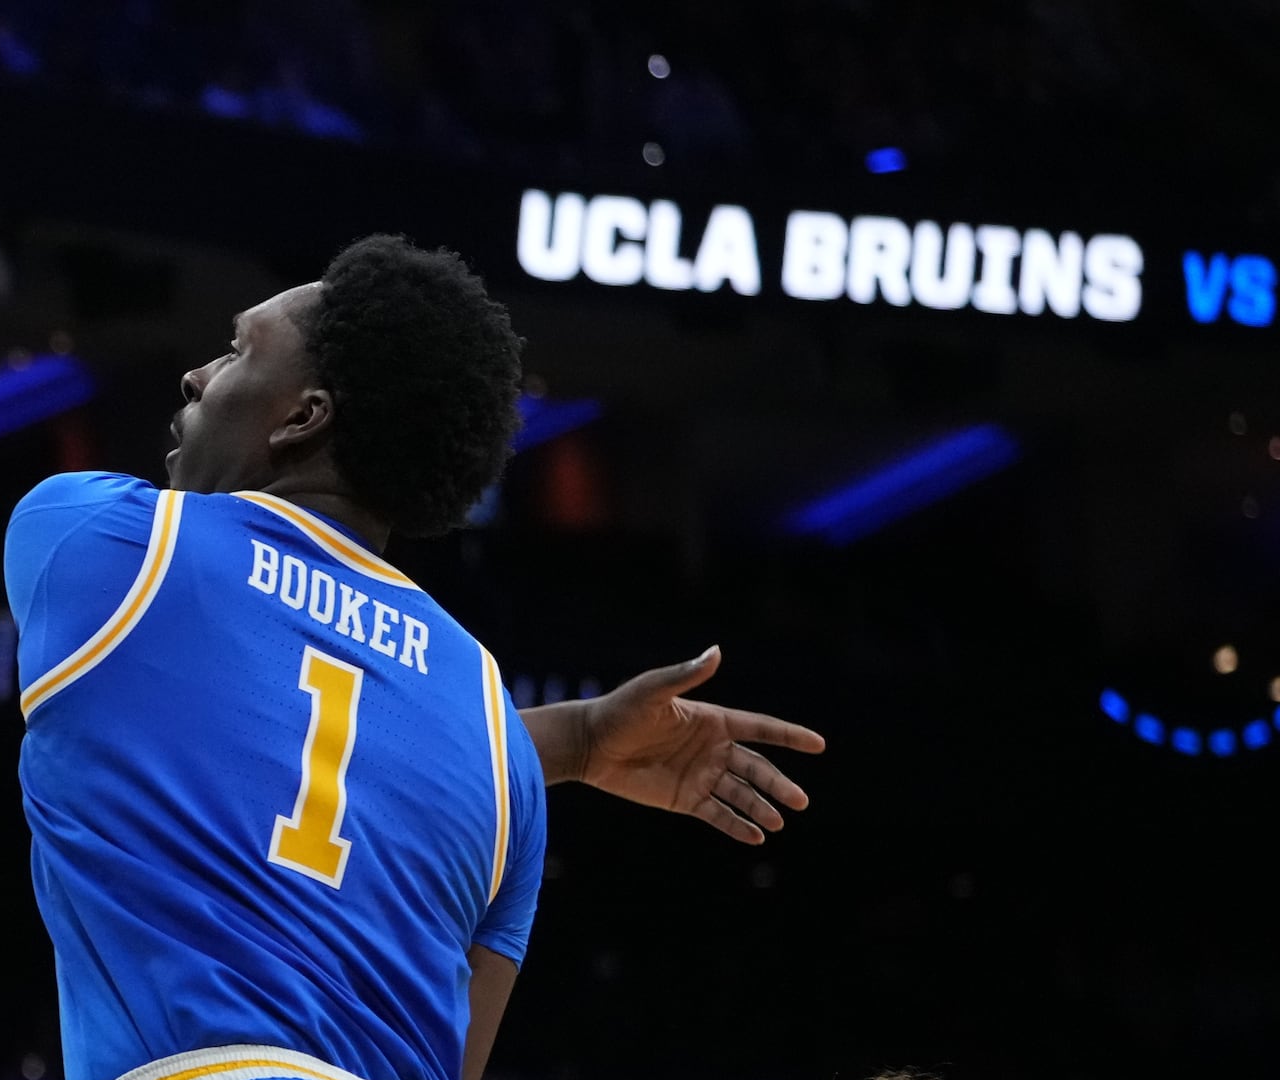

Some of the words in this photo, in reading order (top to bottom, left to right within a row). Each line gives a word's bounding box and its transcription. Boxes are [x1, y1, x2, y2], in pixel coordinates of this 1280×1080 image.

[517, 189, 761, 296] UCLA
[782, 210, 1143, 322] BRUINS
[1183, 250, 1276, 327] VS
[247, 539, 430, 676] BOOKER
[267, 645, 364, 890] 1
